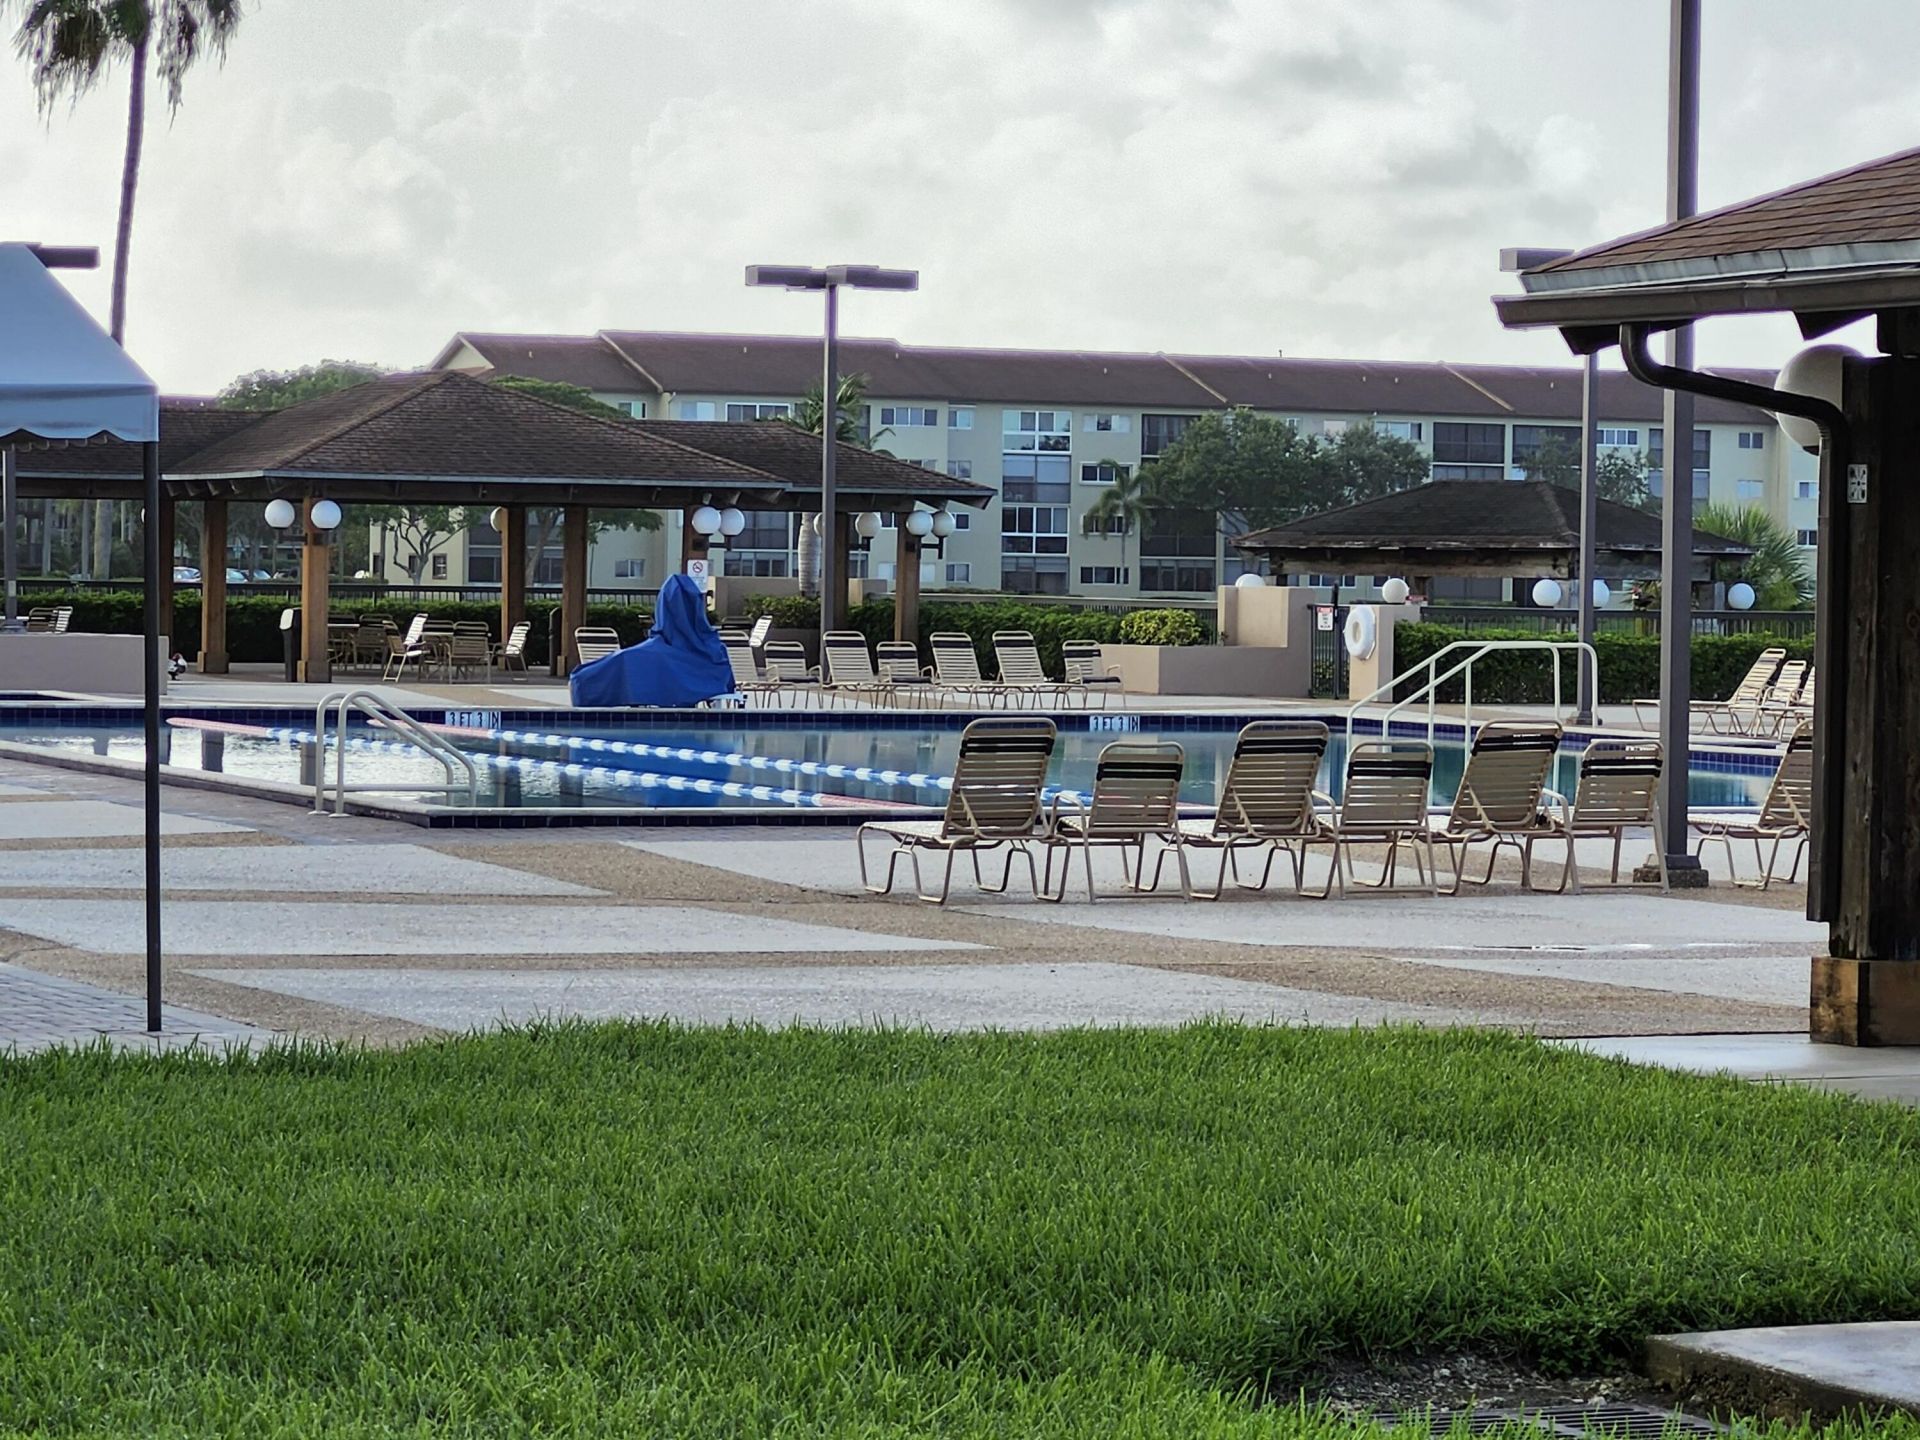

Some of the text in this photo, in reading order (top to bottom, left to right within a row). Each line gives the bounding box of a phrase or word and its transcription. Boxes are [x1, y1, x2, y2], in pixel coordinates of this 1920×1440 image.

[450, 711, 500, 729] 3 FT 3 IN
[1102, 716, 1114, 731] FT
[1128, 716, 1139, 732] IN
